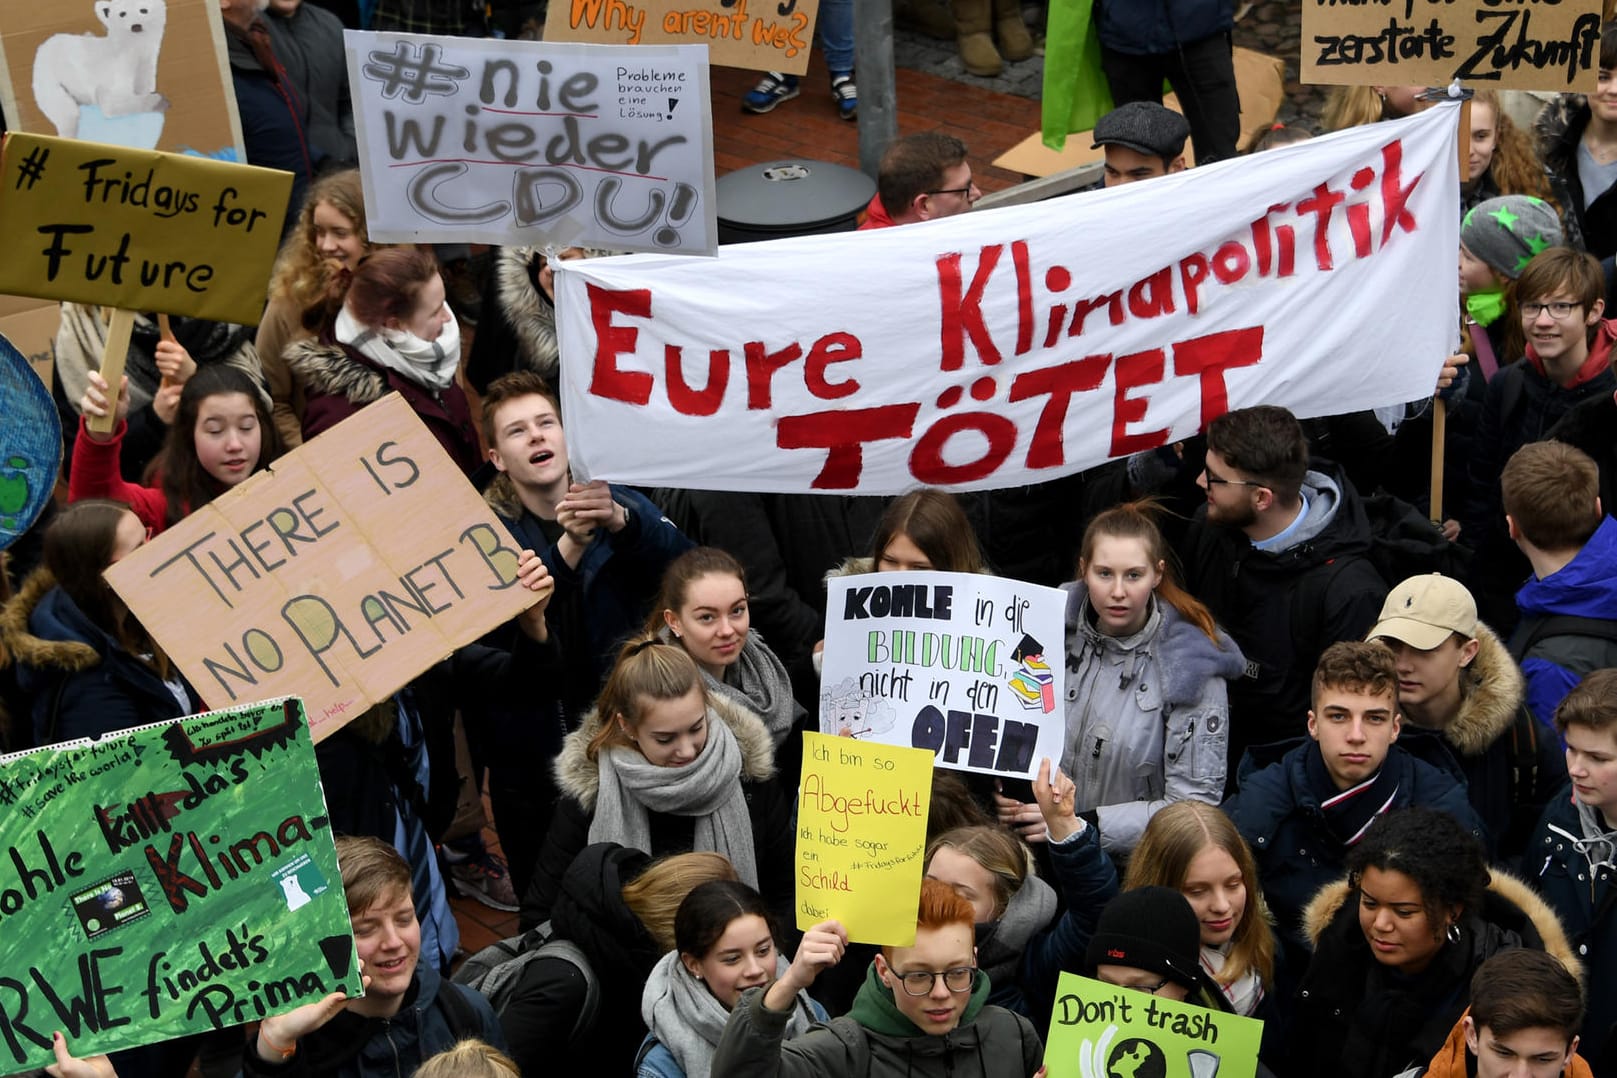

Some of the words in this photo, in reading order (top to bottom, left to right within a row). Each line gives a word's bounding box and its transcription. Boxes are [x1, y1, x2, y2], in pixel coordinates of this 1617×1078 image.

[570, 0, 645, 44] Why
[1452, 9, 1601, 84] Zukunft
[617, 67, 686, 82] Probleme
[618, 83, 682, 93] brauchen
[619, 97, 647, 105] eine
[385, 105, 687, 174] wieder
[213, 187, 266, 232] for
[406, 162, 698, 248] CDU!
[38, 224, 213, 292] Future
[585, 282, 863, 417] Eure
[935, 139, 1425, 372] Klimapolitik
[776, 325, 1264, 489] TÖTET
[149, 489, 340, 609] THERE
[359, 441, 420, 496] IS
[202, 627, 284, 700] NO
[281, 548, 466, 688] PLANET
[459, 522, 521, 590] B
[844, 584, 953, 621] KOHLE
[975, 592, 994, 627] in
[1004, 594, 1030, 635] die
[859, 668, 914, 703] nicht
[929, 677, 950, 706] in
[966, 684, 998, 714] den
[812, 742, 830, 763] Ich
[874, 757, 895, 771] so
[912, 705, 1039, 773] OFEN
[64, 770, 88, 787] the
[183, 757, 250, 811] das
[802, 774, 922, 833] Abgefuckt
[802, 850, 819, 862] ein
[819, 828, 848, 847] habe
[855, 839, 888, 857] sogar
[800, 865, 853, 892] Schild
[801, 900, 829, 919] dabei
[0, 947, 131, 1064] RWE
[187, 934, 354, 1028] Prima!
[1057, 994, 1132, 1025] Don't
[1144, 999, 1218, 1044] trash
